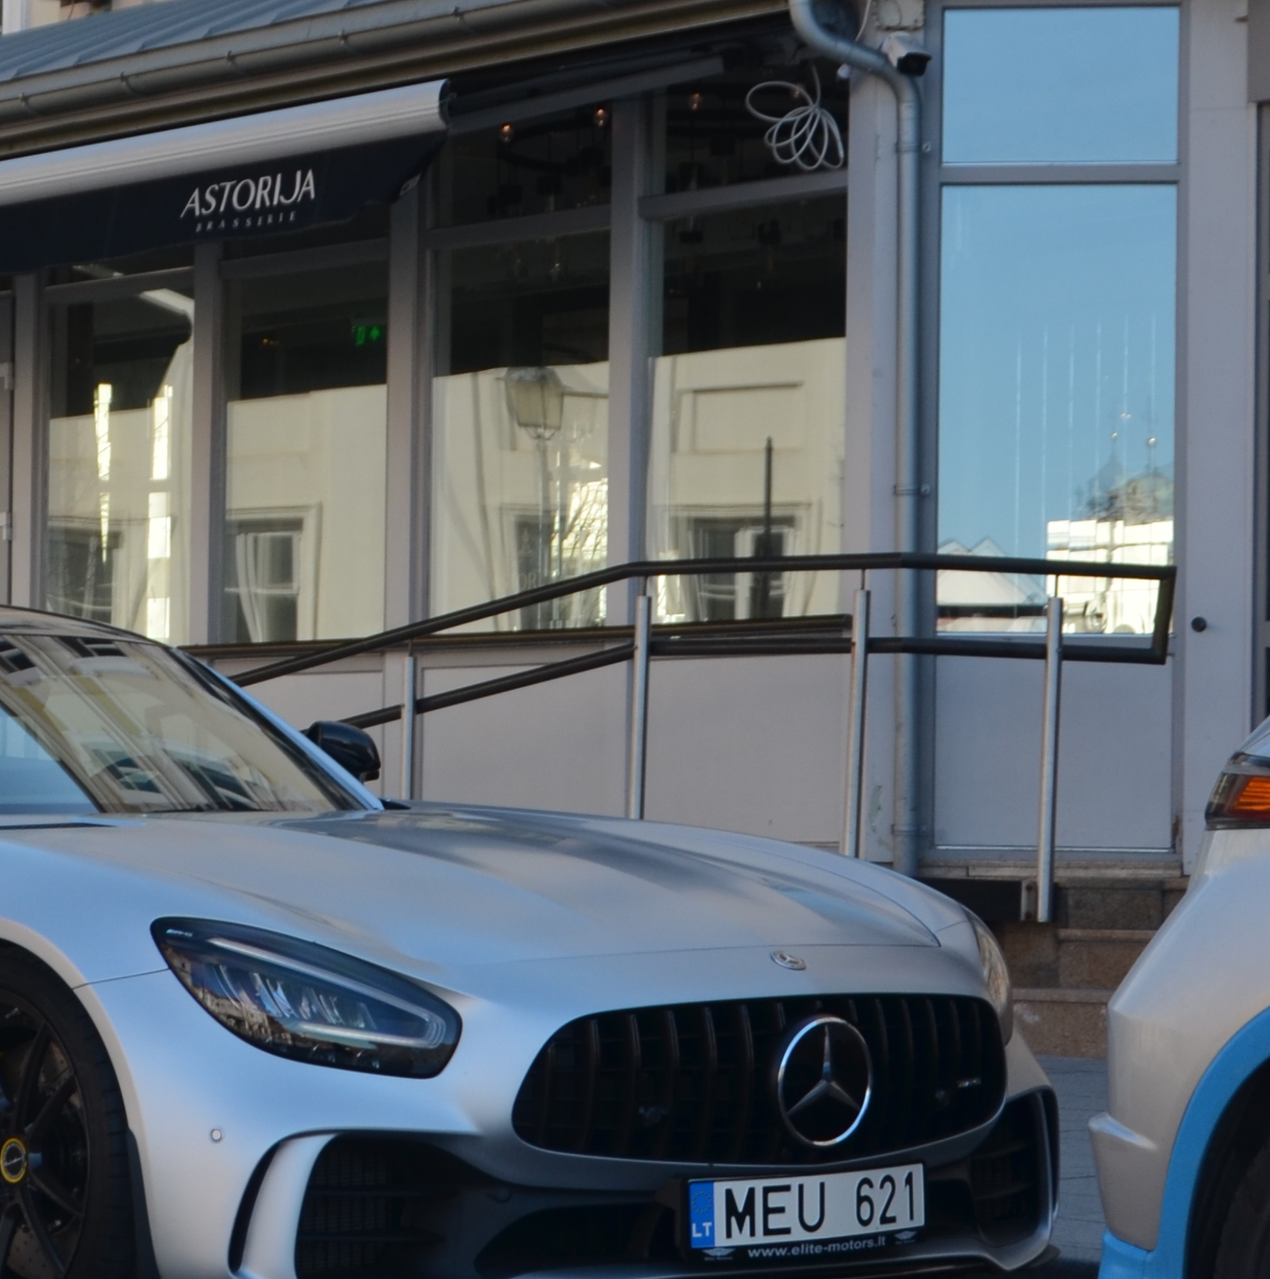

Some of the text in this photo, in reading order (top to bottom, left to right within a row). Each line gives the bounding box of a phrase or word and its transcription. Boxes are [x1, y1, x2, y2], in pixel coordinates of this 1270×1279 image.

[180, 169, 315, 218] ASTORIJA
[195, 211, 297, 232] BRASSERIE
[725, 1171, 914, 1239] MEU 621
[692, 1222, 712, 1237] LT
[748, 1237, 886, 1258] www.elite-motors.lt
